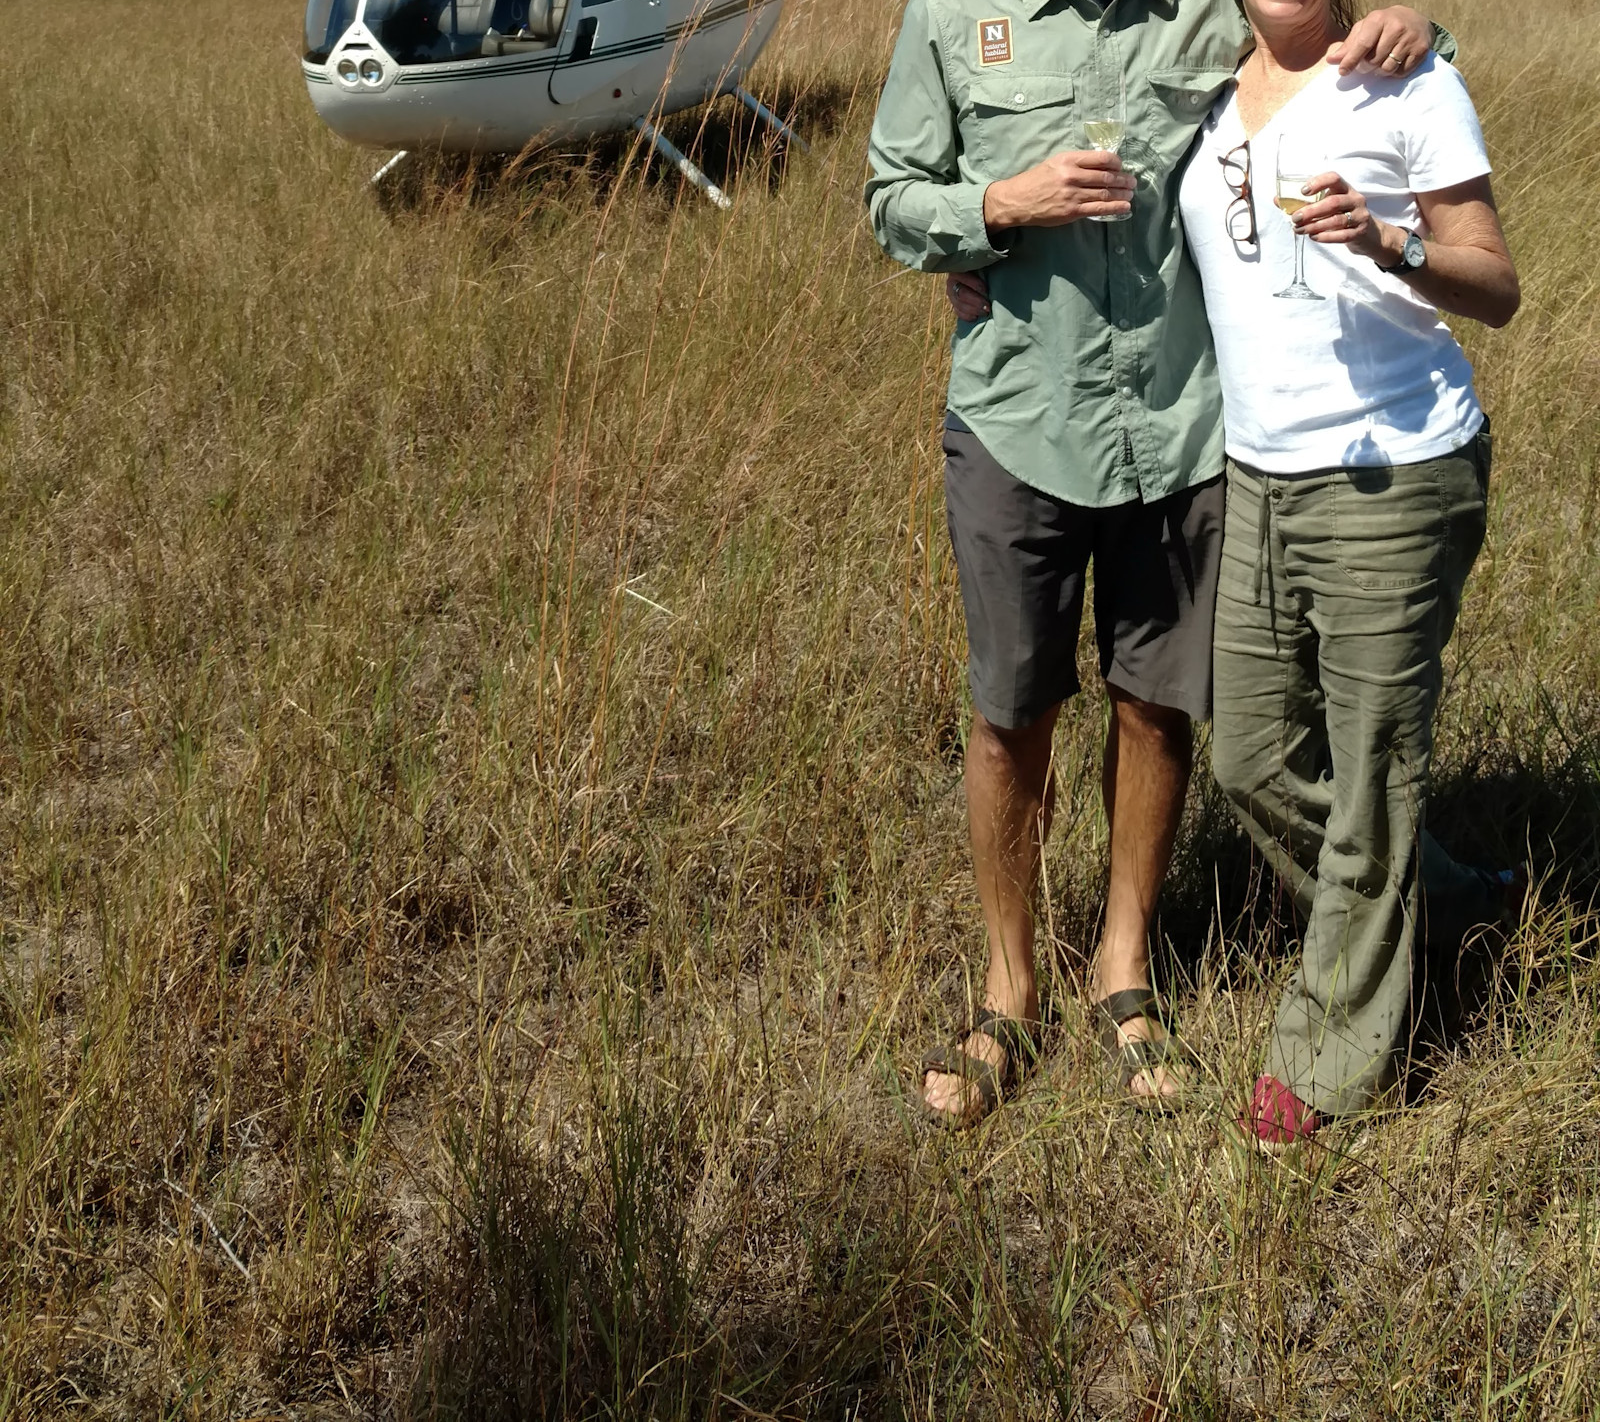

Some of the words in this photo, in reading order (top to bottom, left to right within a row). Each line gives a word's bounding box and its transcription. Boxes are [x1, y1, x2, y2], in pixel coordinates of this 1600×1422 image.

[985, 24, 1005, 41] N
[984, 42, 1007, 51] natural
[984, 48, 1008, 57] habitat
